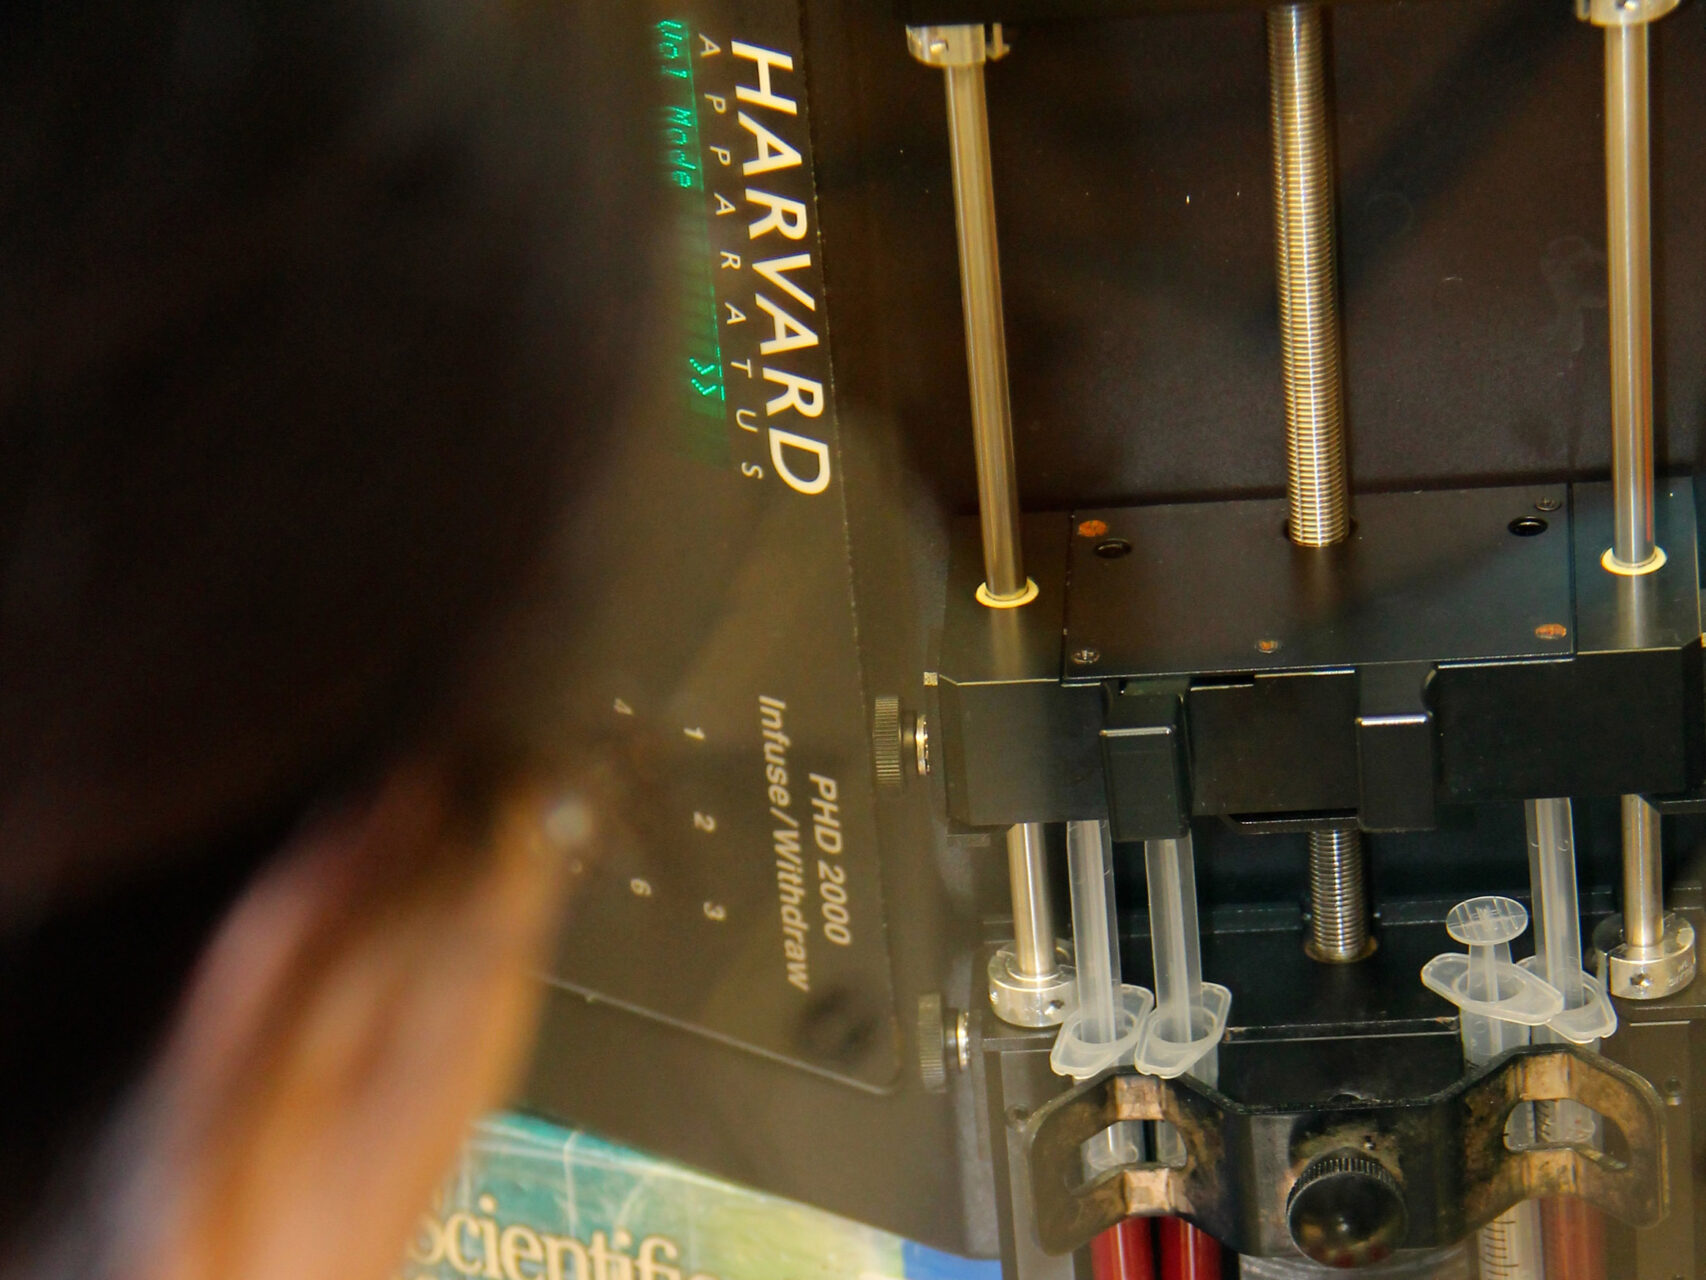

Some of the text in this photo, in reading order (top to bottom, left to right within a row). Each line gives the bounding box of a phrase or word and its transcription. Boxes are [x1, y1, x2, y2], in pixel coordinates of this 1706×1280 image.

[655, 17, 689, 80] Vol
[669, 105, 697, 190] Mode
[699, 32, 764, 480] APPARATUS
[731, 40, 831, 496] HARVARD
[613, 698, 635, 717] 4
[683, 725, 707, 741] 1
[693, 811, 717, 833] 2
[757, 694, 810, 992] Infuse/Withdraw
[630, 877, 653, 897] 6
[808, 772, 852, 947] PHD 2000
[702, 901, 728, 922] 3
